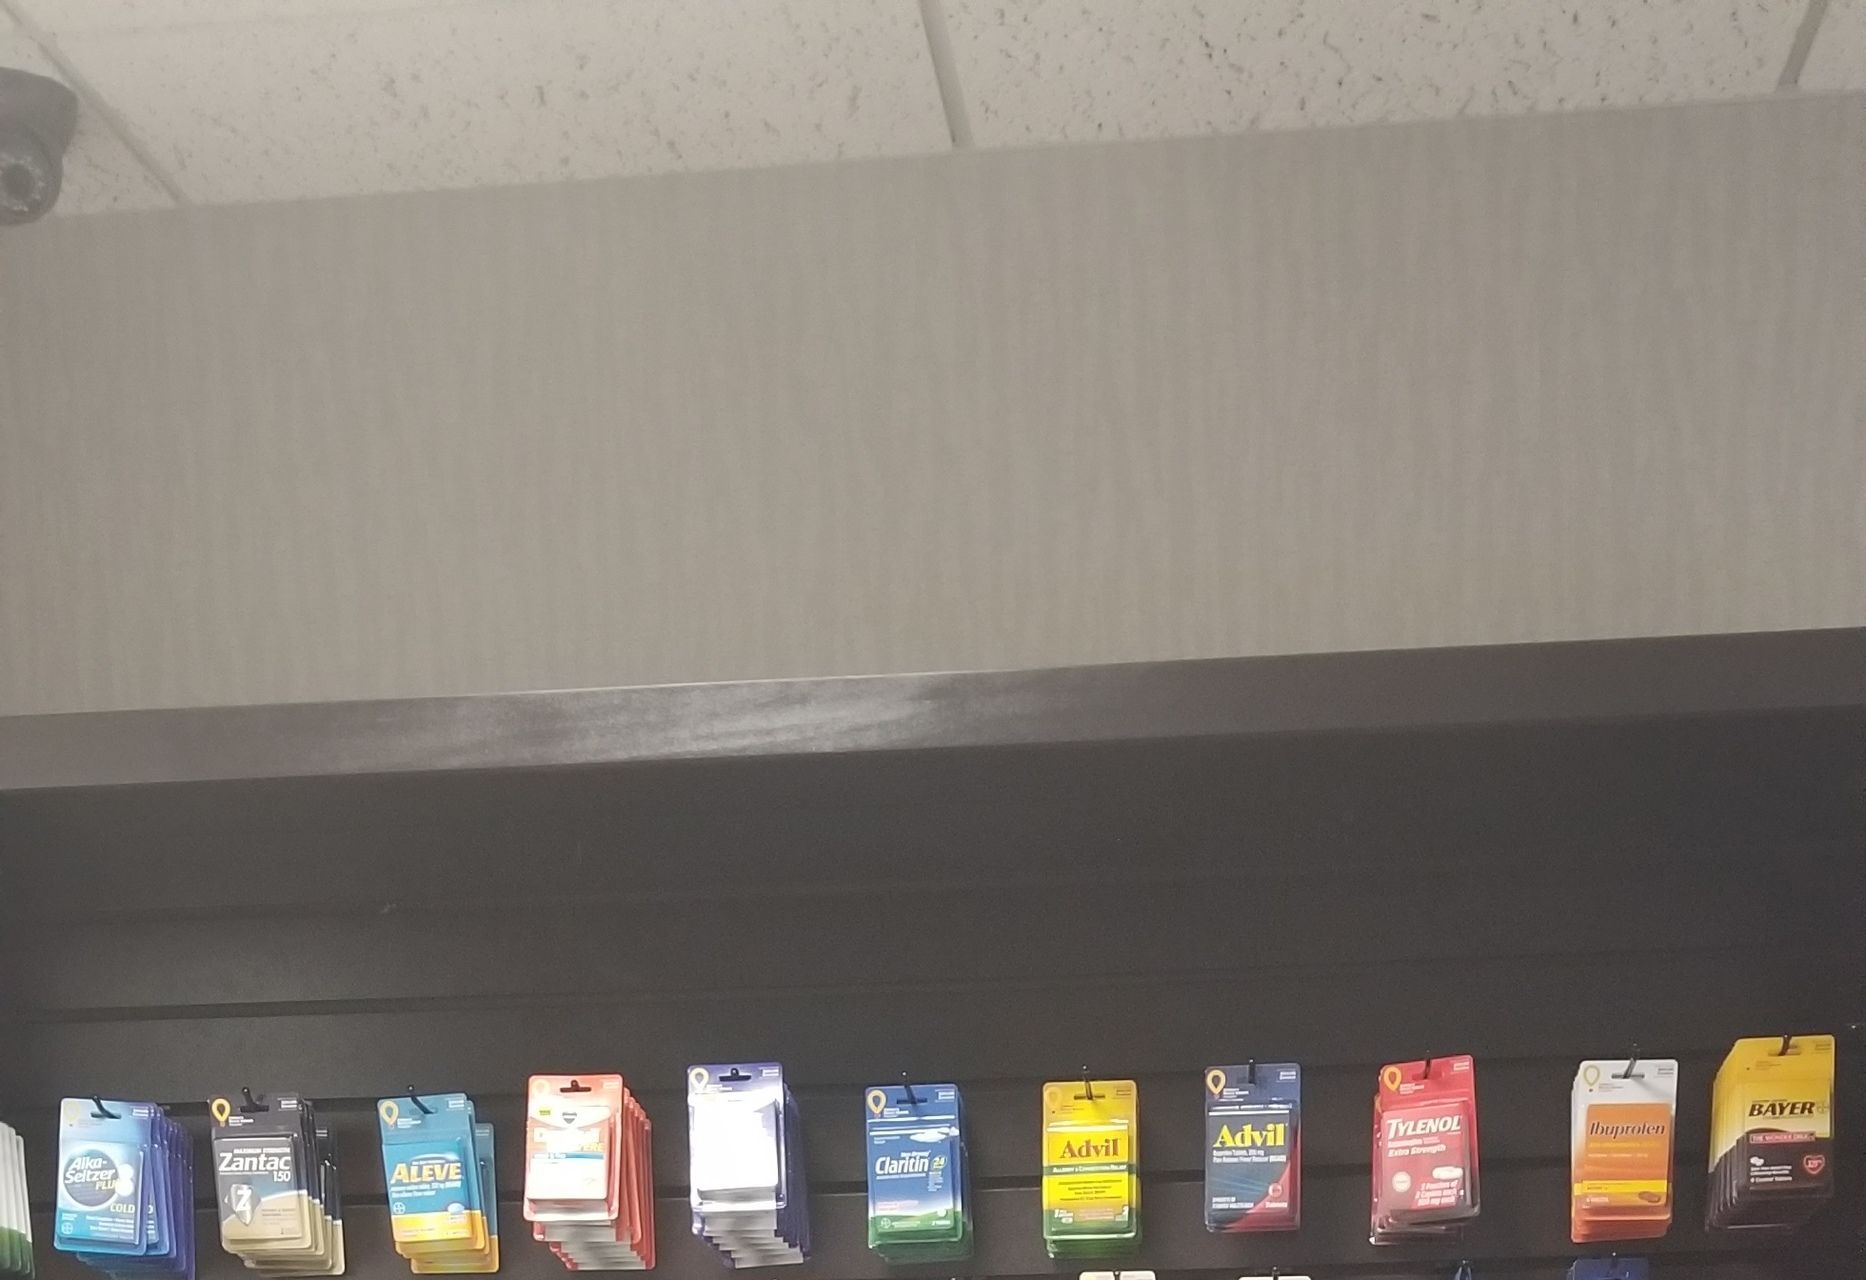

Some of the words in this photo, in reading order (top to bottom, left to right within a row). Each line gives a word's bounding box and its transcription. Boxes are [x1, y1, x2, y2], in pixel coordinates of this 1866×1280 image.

[1749, 1101, 1815, 1117] BAYER
[1213, 1123, 1285, 1148] Advil
[1387, 1115, 1462, 1139] TYLENOL
[1590, 1122, 1665, 1139] Ibuprofen
[1059, 1138, 1119, 1158] Advil
[69, 1157, 108, 1171] Alka-
[218, 1152, 291, 1171] Zantac
[875, 1155, 929, 1174] Claritin
[65, 1169, 115, 1184] Seltzer
[273, 1171, 291, 1182] 150
[390, 1162, 462, 1184] ALEVE
[110, 1203, 136, 1213] COLD
